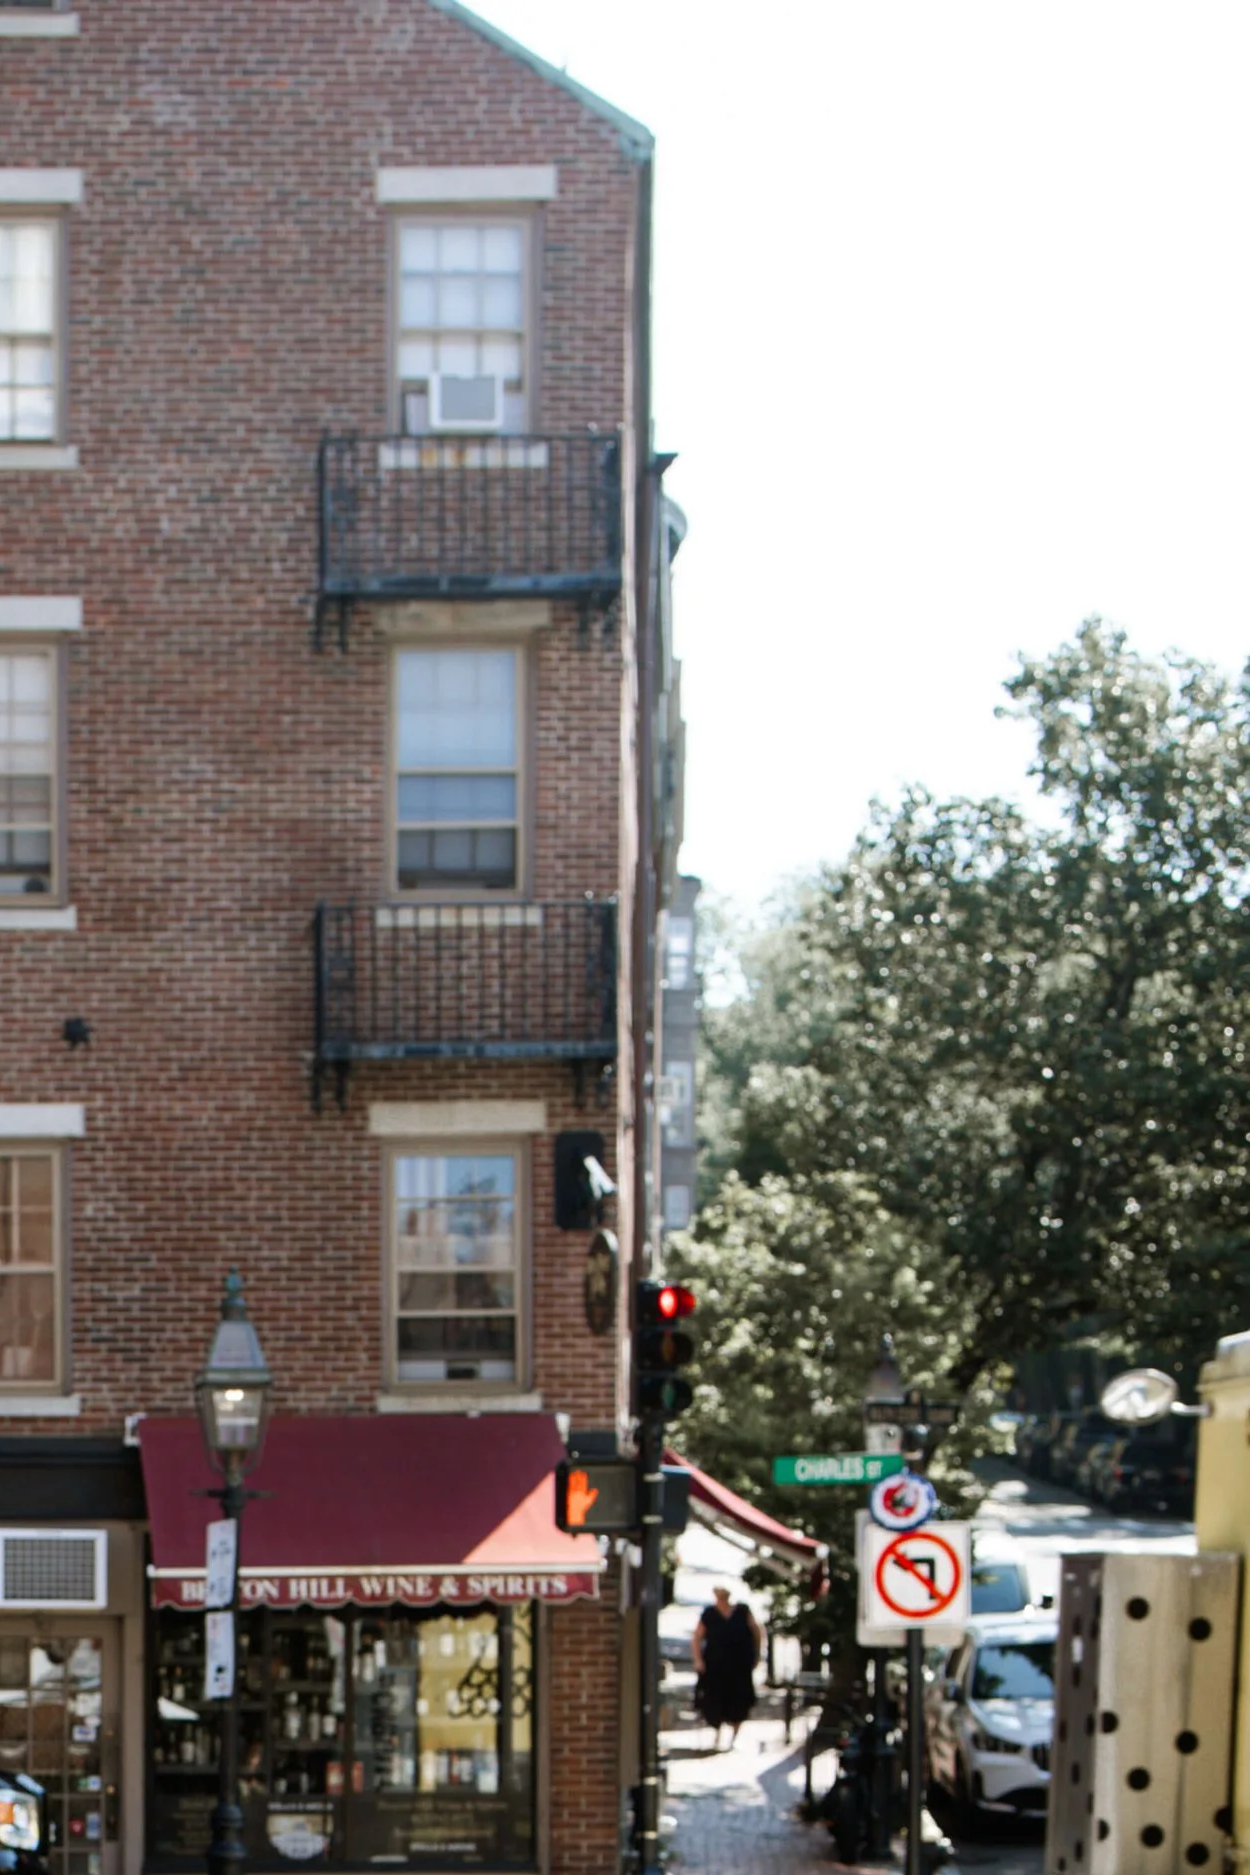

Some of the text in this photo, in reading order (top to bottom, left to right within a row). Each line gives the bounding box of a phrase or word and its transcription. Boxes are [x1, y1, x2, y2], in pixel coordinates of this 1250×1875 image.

[794, 1458, 883, 1481] CHARLES ST
[181, 1575, 568, 1601] BEON HILL WINE & SPIRITS
